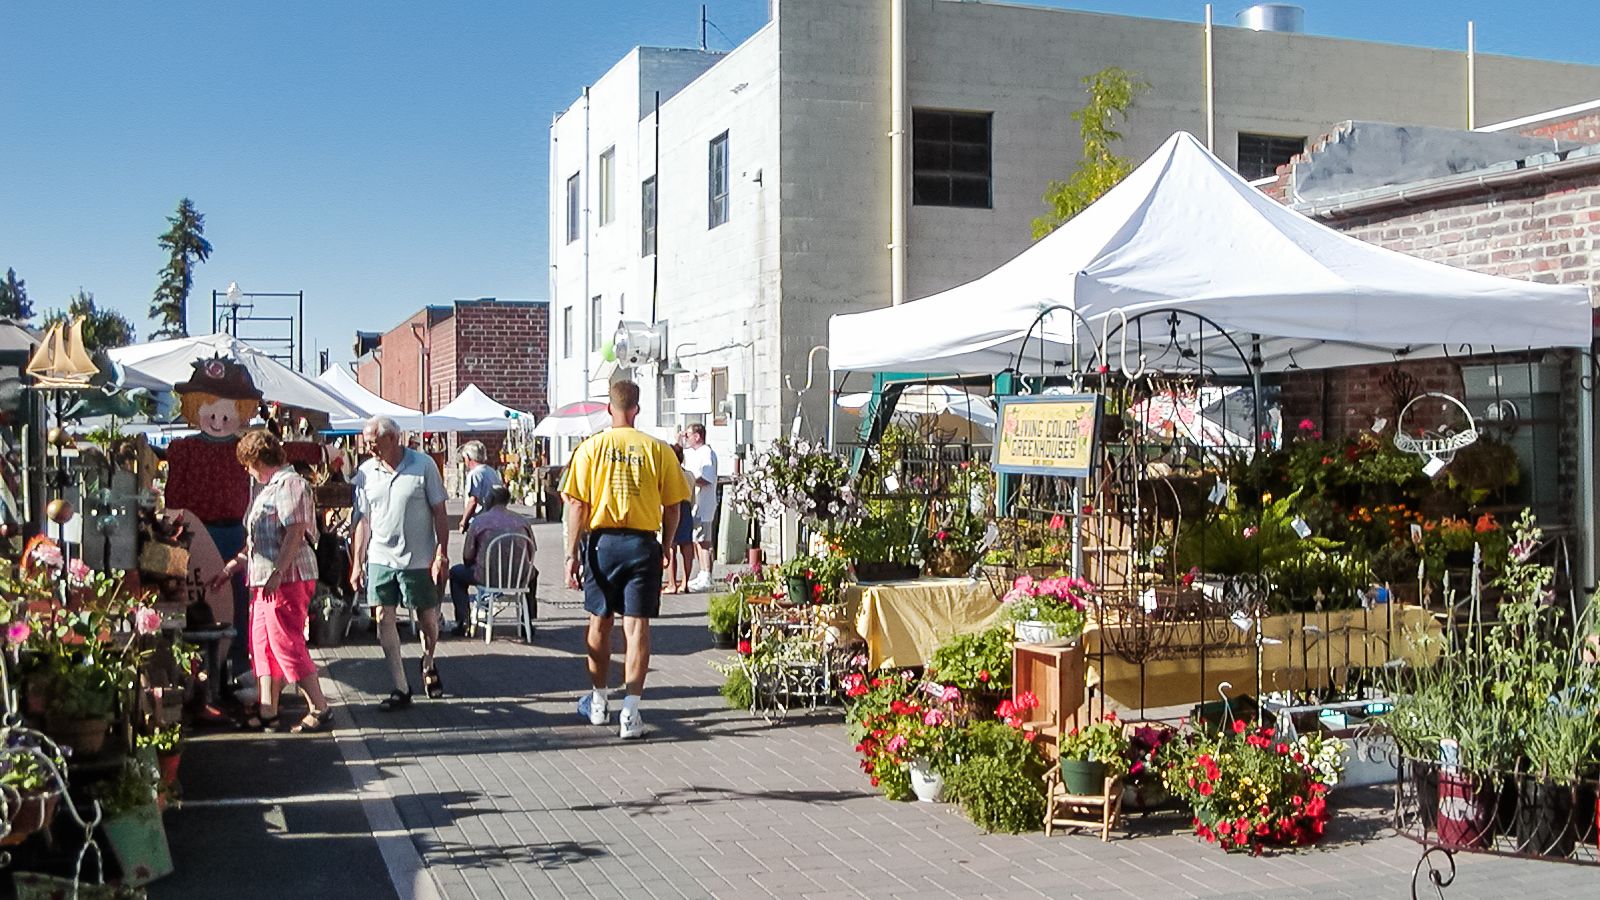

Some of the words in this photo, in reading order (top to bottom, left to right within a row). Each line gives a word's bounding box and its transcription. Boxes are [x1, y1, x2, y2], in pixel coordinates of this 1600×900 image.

[1015, 419, 1044, 437] LIVING
[1046, 420, 1079, 438] COLOR
[1011, 439, 1077, 459] GREENHOUSES
